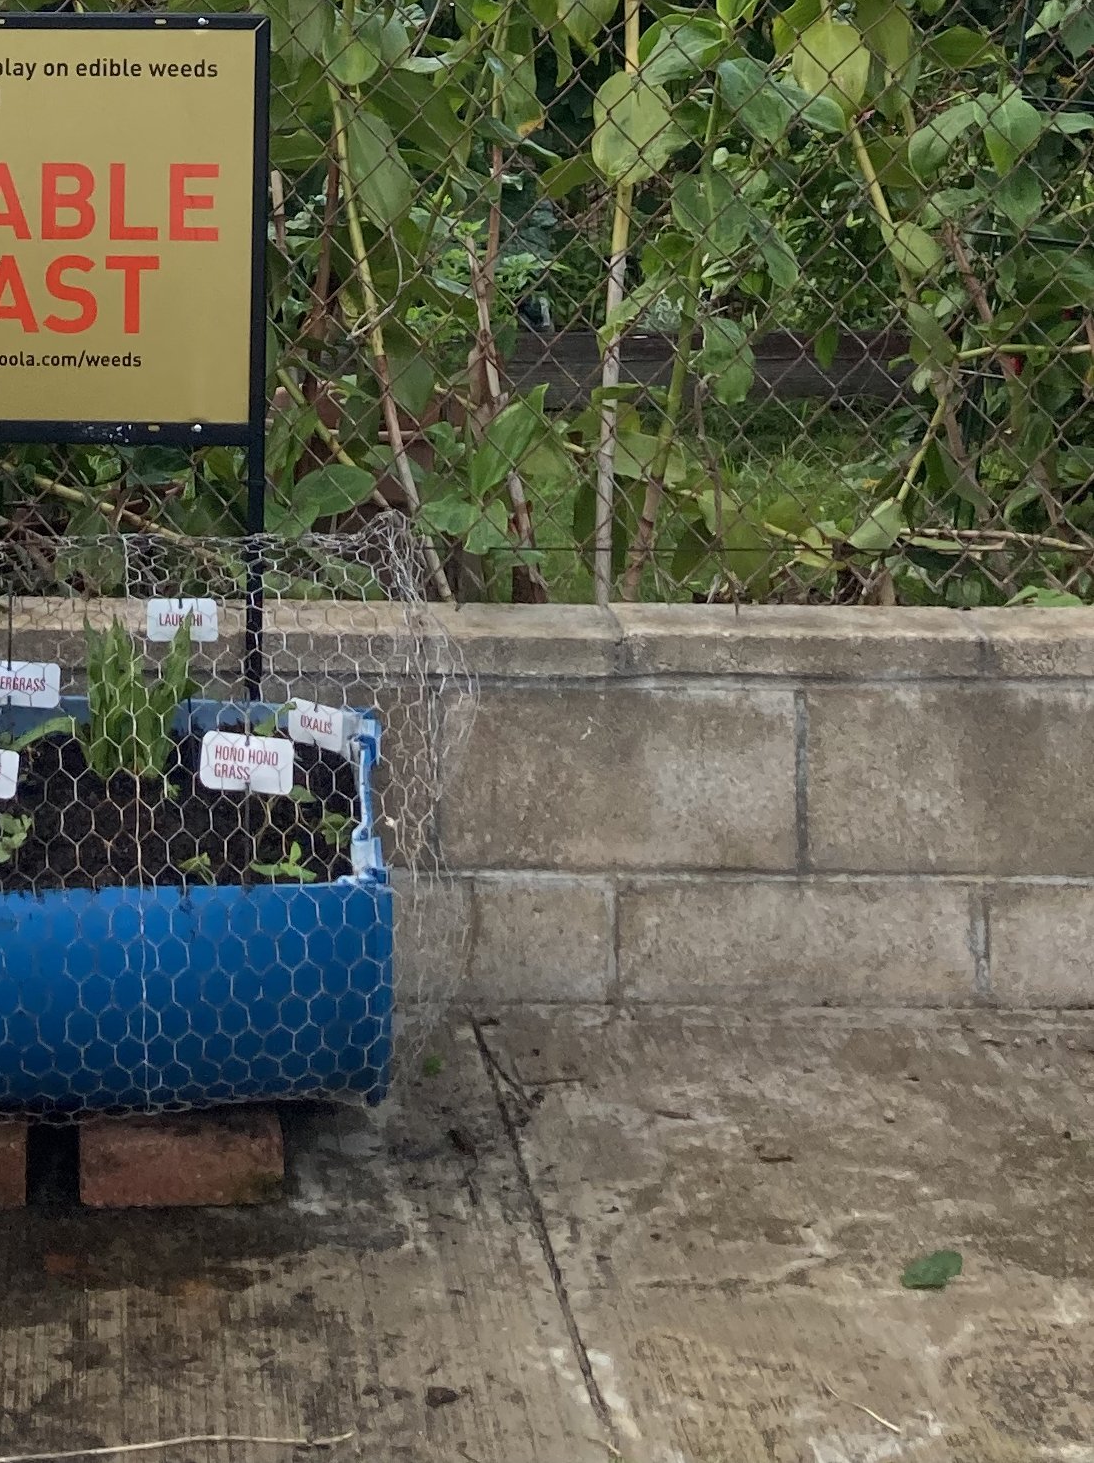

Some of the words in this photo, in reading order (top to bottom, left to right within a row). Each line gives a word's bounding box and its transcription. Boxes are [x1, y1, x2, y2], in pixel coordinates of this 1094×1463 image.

[43, 62, 69, 78] on
[76, 57, 142, 78] edible
[148, 57, 218, 79] weeds
[300, 714, 333, 735] OXALIS
[214, 744, 245, 763] HONO
[248, 748, 279, 766] HONO
[214, 762, 251, 780] GRASS
